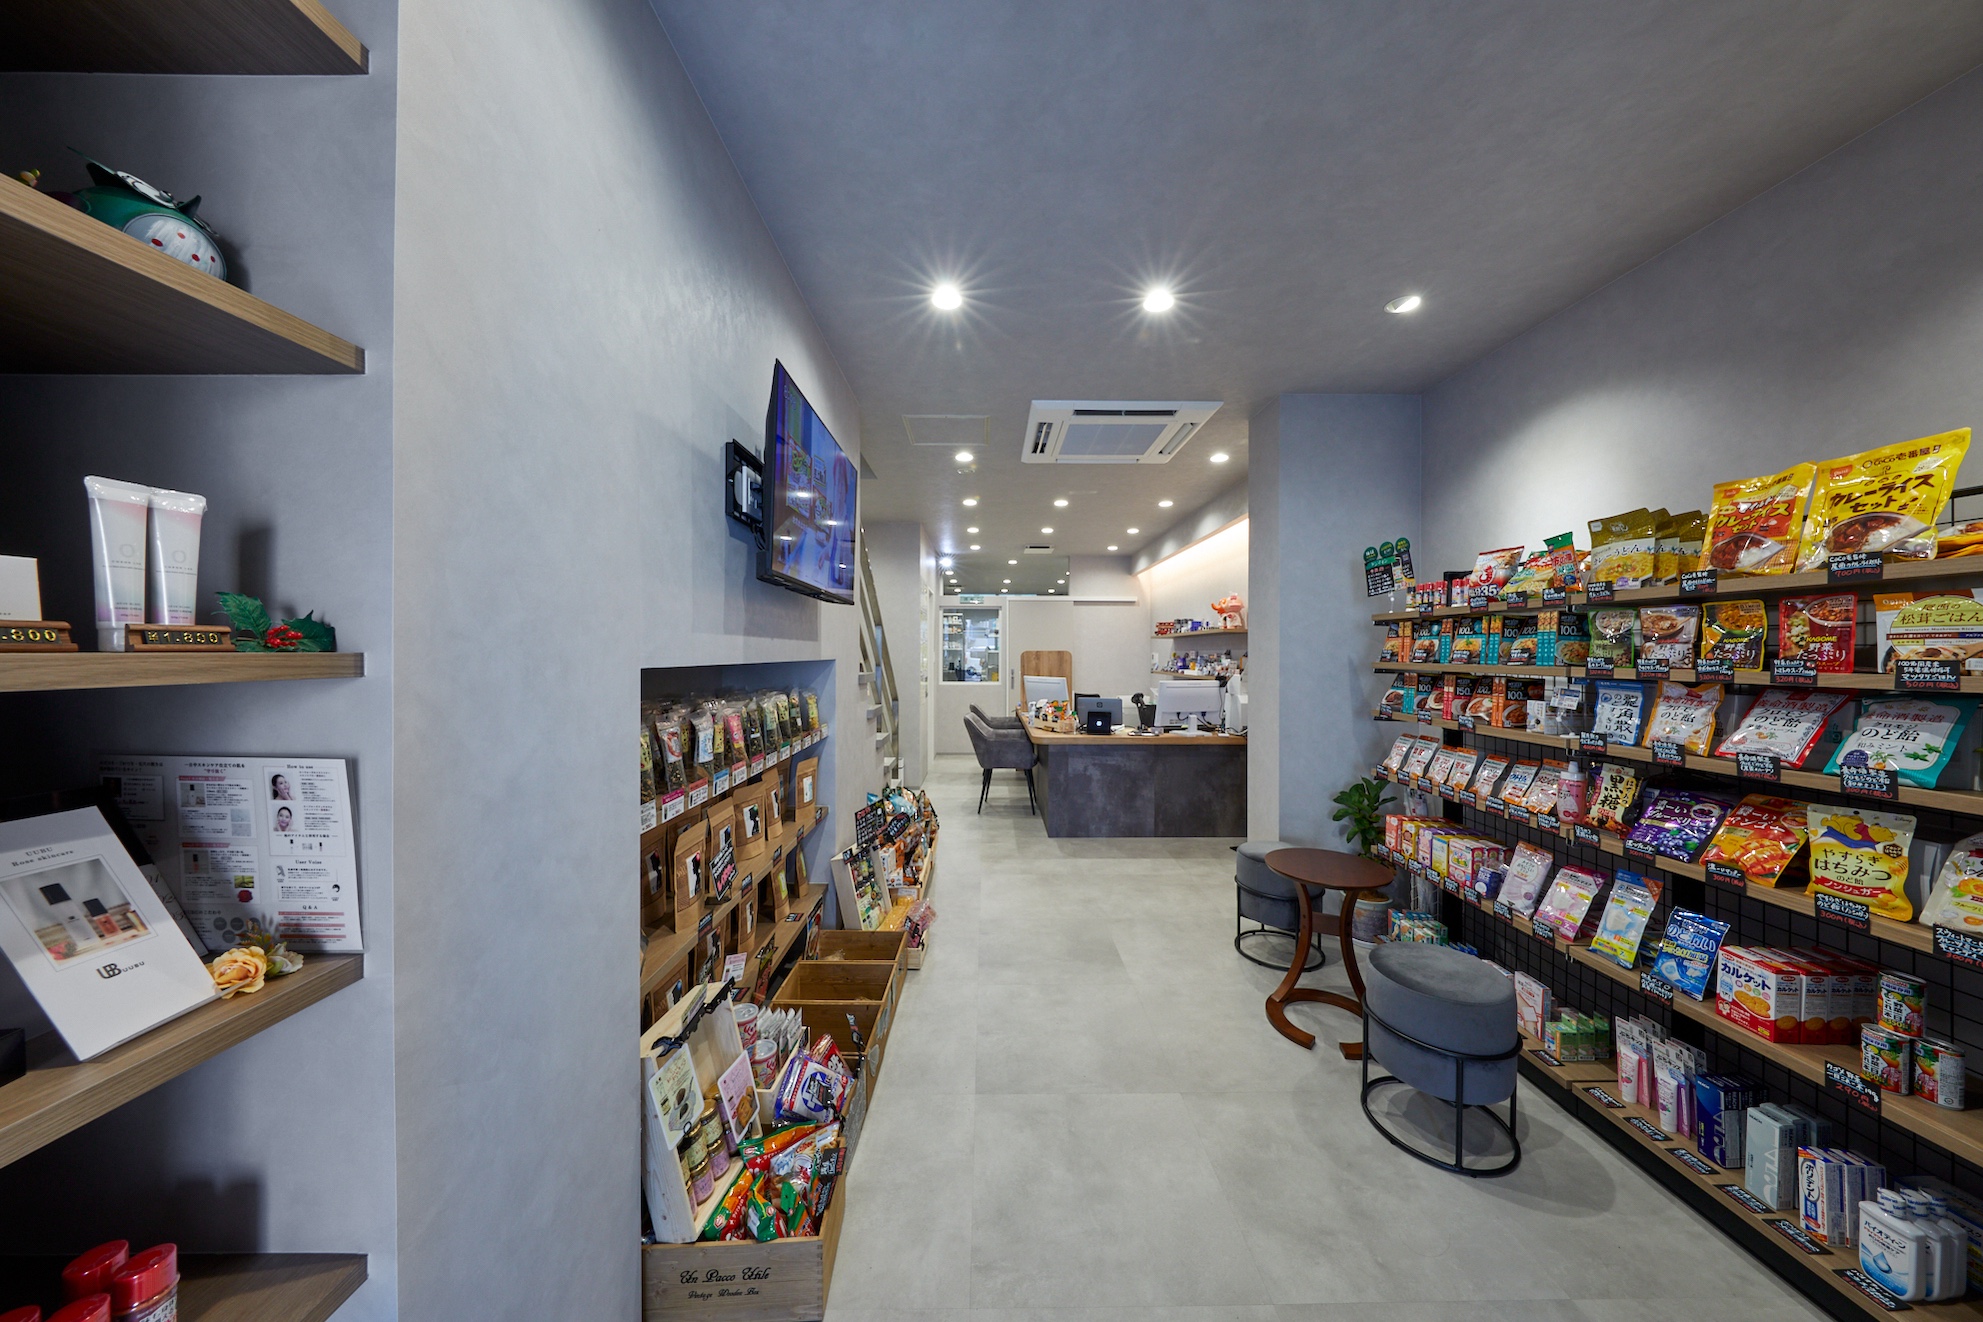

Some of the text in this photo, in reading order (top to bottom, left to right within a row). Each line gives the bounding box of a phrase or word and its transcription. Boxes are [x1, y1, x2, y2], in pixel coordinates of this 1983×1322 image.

[1830, 473, 1935, 509] カレーライス
[1850, 496, 1897, 513] セット
[1481, 585, 1498, 597] 35
[1922, 603, 1961, 611] 尾西の
[1900, 612, 1983, 625] 松茸ごはん
[1714, 649, 1755, 660] たっぷり
[1809, 643, 1834, 652] 野菜
[1797, 650, 1846, 661] たっぷり
[1757, 699, 1828, 713] 養命酒製造
[1613, 693, 1639, 741] 龍角散の
[1661, 711, 1696, 723] のど飴
[1755, 714, 1802, 728] のど飴
[1862, 711, 1944, 723] 養命酒製造
[1861, 728, 1920, 742] のど飴
[1857, 741, 1908, 753] 和みミント
[1597, 774, 1625, 811] 黒糖
[1657, 800, 1687, 814] 濃ーい
[1736, 804, 1777, 821] 濃ーい
[1648, 808, 1702, 827] ブルーベリー
[1728, 815, 1786, 833] マンゴー
[11, 849, 74, 867] Rose skincare
[25, 846, 53, 857] UUBU
[1822, 848, 1882, 866] やすらぎ
[1814, 858, 1892, 881] はちみつ
[1836, 875, 1864, 886] のど飴
[1824, 880, 1881, 898] ノンシュガー
[1720, 962, 1771, 991] カルケット
[1864, 1220, 1906, 1249] バイオティーン
[679, 1270, 699, 1284] Un
[702, 1269, 736, 1283] Pacco
[688, 1287, 760, 1301] Vintage Wooden Box
